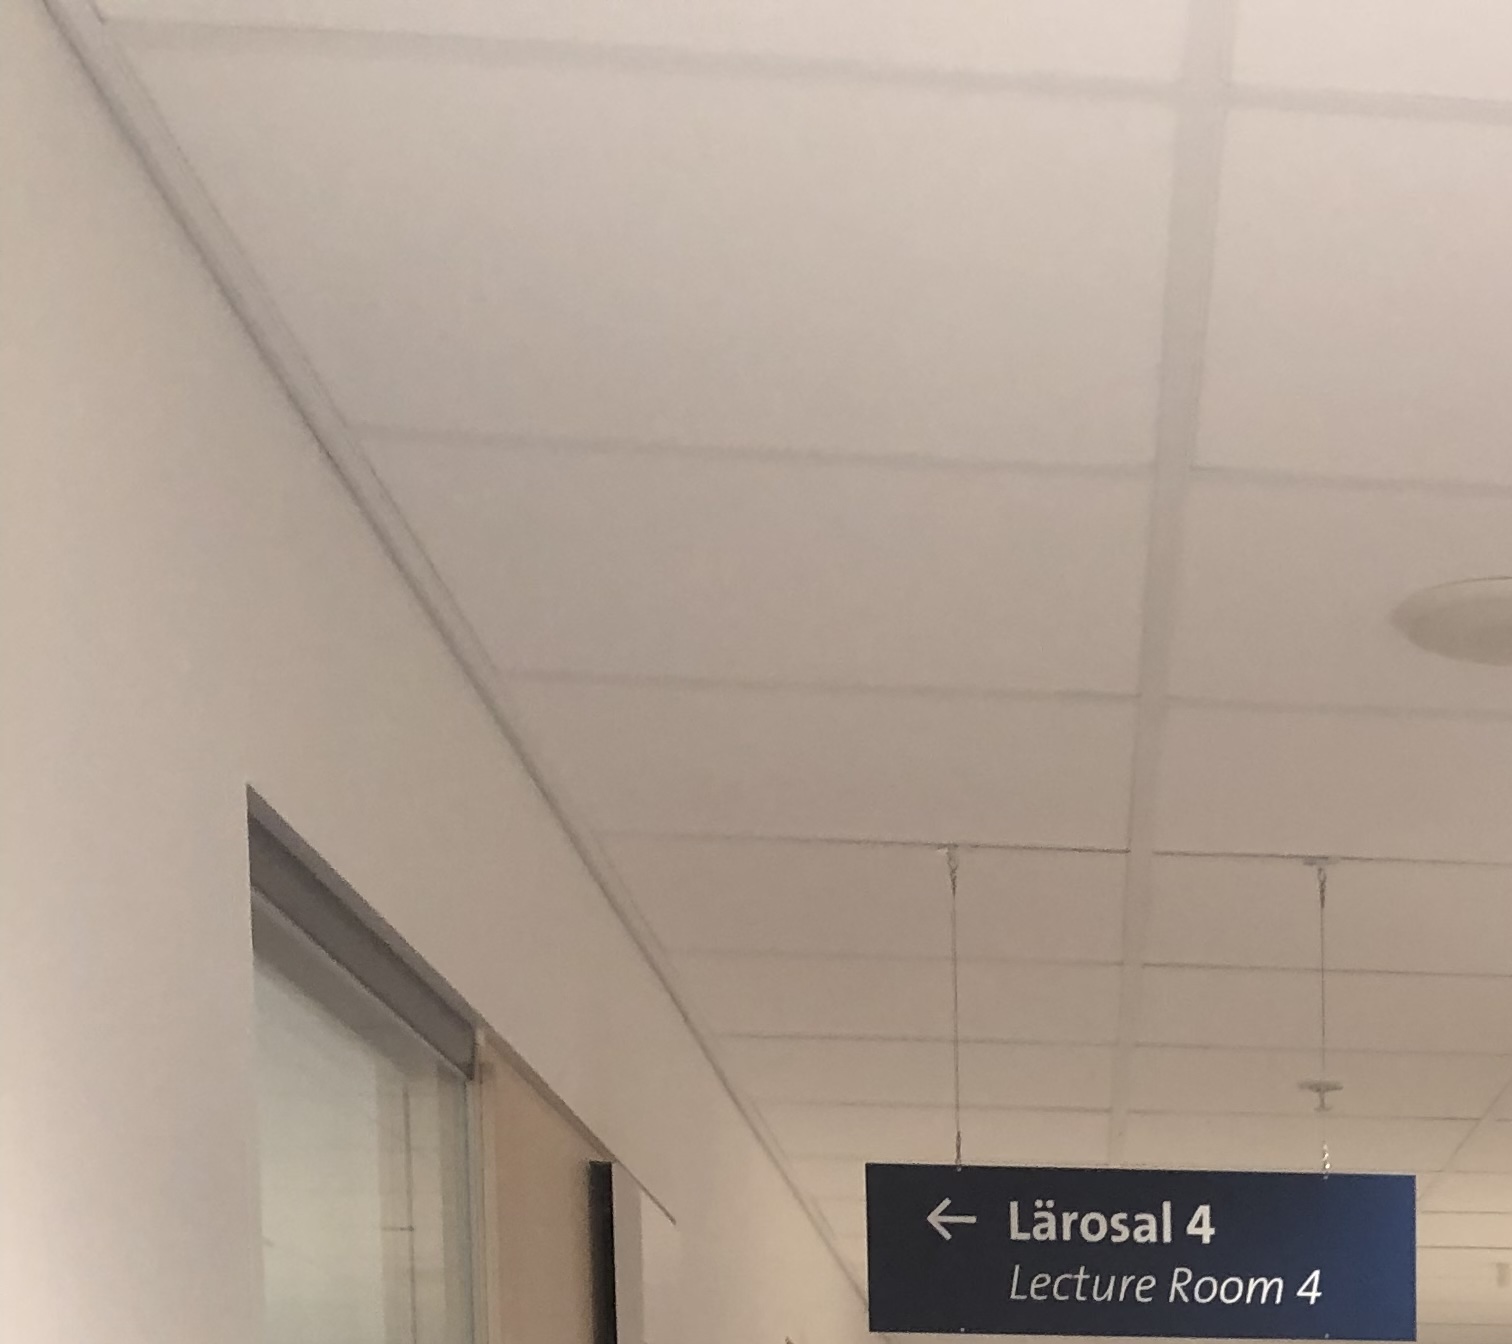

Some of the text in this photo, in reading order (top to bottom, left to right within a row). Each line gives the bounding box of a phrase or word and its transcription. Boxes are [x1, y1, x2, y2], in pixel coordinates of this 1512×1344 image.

[1009, 1199, 1216, 1245] Lärosal 4
[1009, 1264, 1324, 1306] Lecture Room 4
